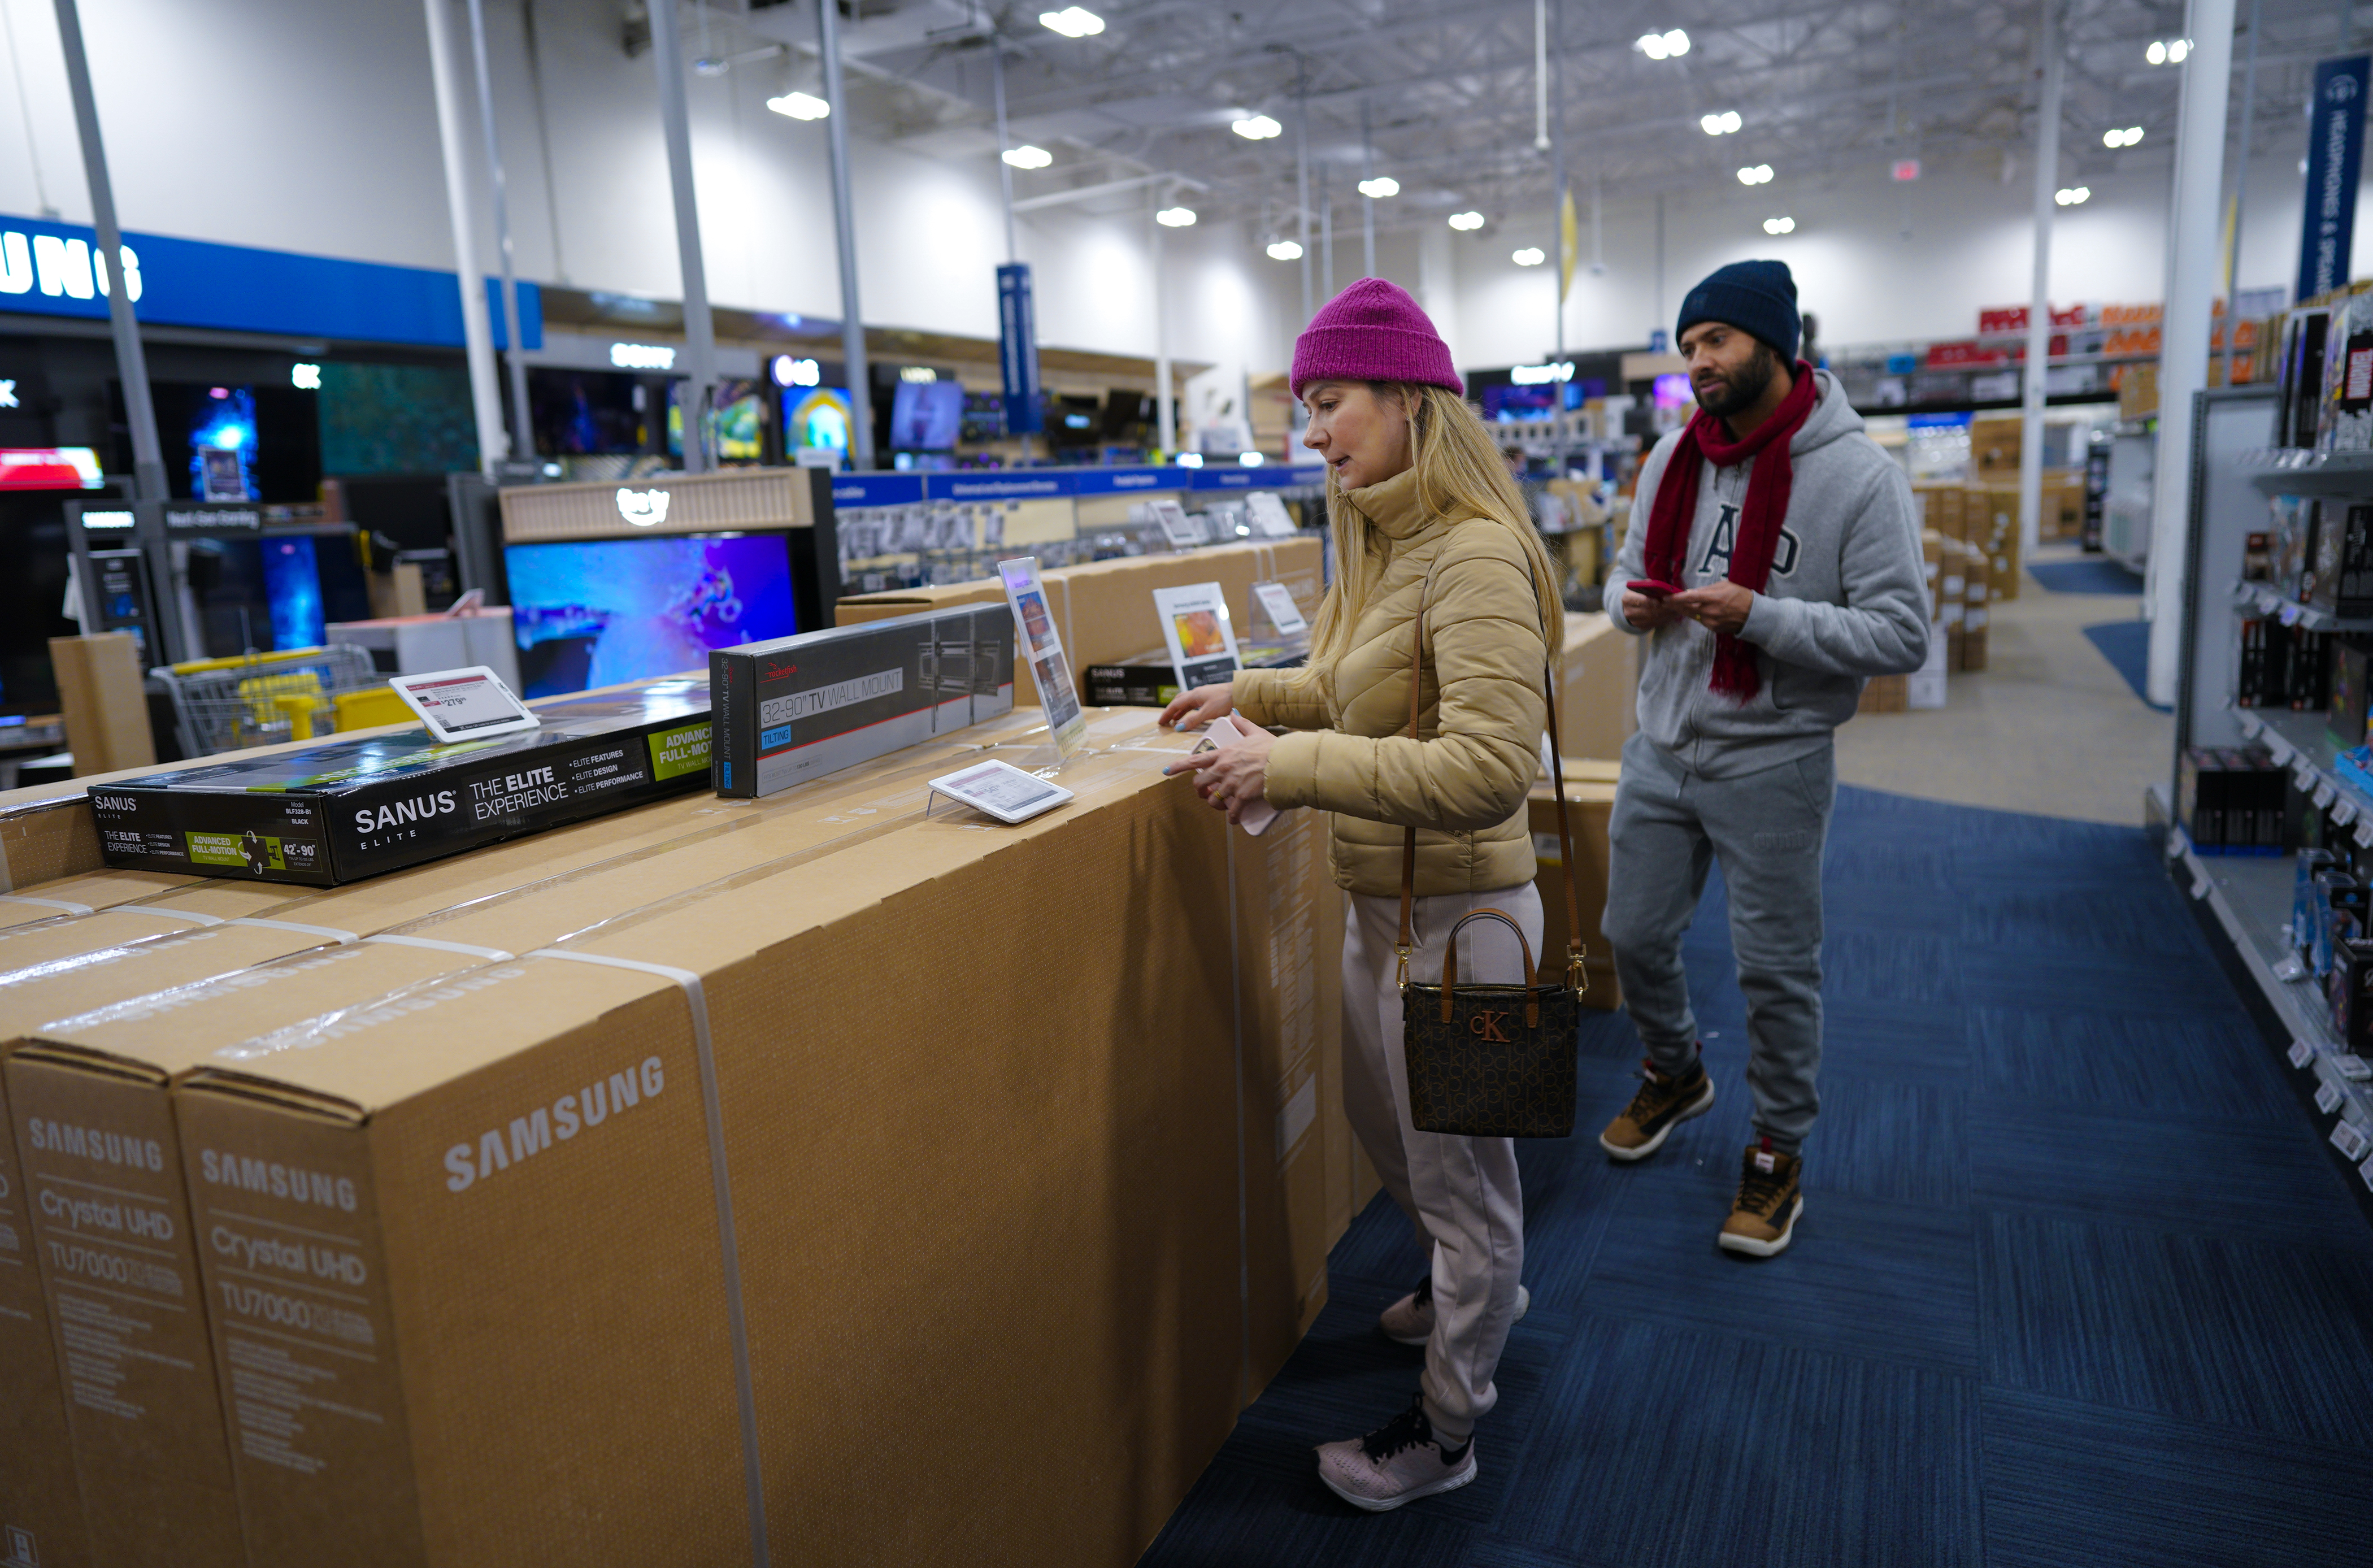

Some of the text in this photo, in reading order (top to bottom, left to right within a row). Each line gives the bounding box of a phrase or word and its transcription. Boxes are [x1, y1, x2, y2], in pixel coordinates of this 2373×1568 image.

[765, 664, 797, 678] rocketfish
[723, 690, 729, 702] TV
[763, 671, 900, 723] 32-90" TV WALL MOUNT
[763, 729, 789, 745] TILTING
[573, 749, 623, 767] ELITE FEATURES
[575, 764, 618, 781] ELITE DESIGN
[470, 766, 554, 800] THE ELITE
[578, 771, 644, 794] ELITE PERFORMANCE
[95, 796, 137, 811] SANUS
[476, 782, 568, 820] EXPERIENCE
[104, 830, 141, 842] THE ELITE
[194, 836, 231, 846] ADVANCED
[360, 829, 416, 850] ELITE
[107, 842, 148, 854] EXPERIENCE
[192, 845, 237, 855] FULL-MOTION
[444, 1056, 664, 1192] SAMSUNG
[29, 1117, 163, 1172] SAMSUNG
[202, 1148, 357, 1211] SAMSUNG
[40, 1189, 173, 1240] Crystal UHD
[211, 1226, 366, 1285] Crystal UHD
